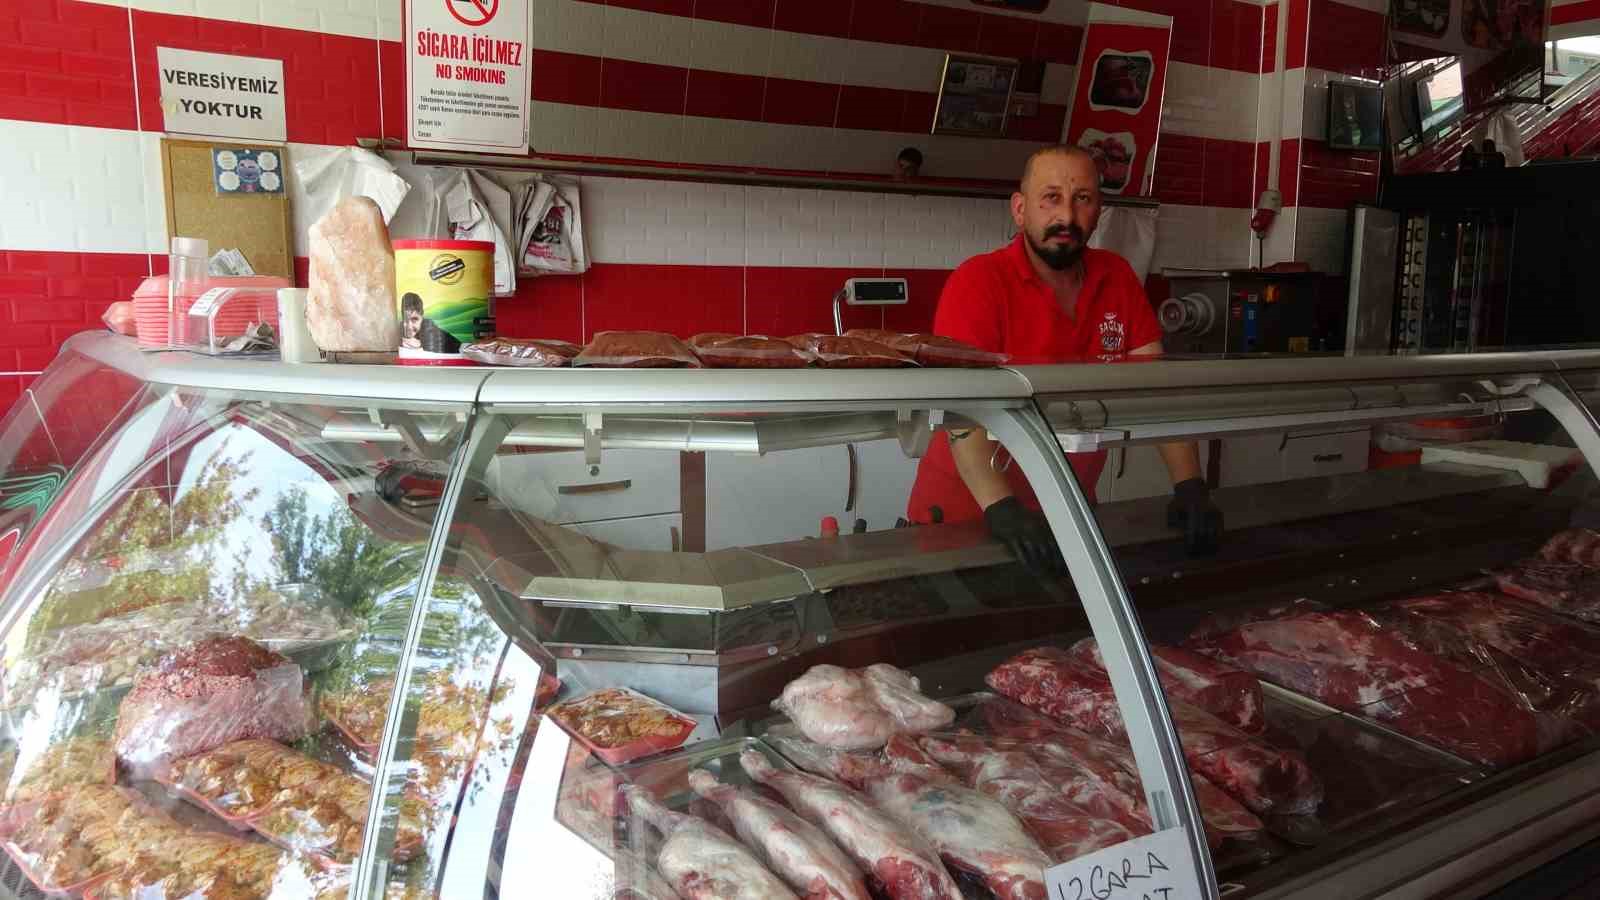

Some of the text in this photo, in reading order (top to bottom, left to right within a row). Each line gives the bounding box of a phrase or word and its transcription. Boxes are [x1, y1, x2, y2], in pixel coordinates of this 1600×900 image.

[417, 28, 523, 66] SİGARA İÇİLMEZ
[163, 68, 279, 95] VERESİYEMİZ
[436, 63, 506, 84] NO SMOKING
[180, 98, 263, 120] YOKTUR
